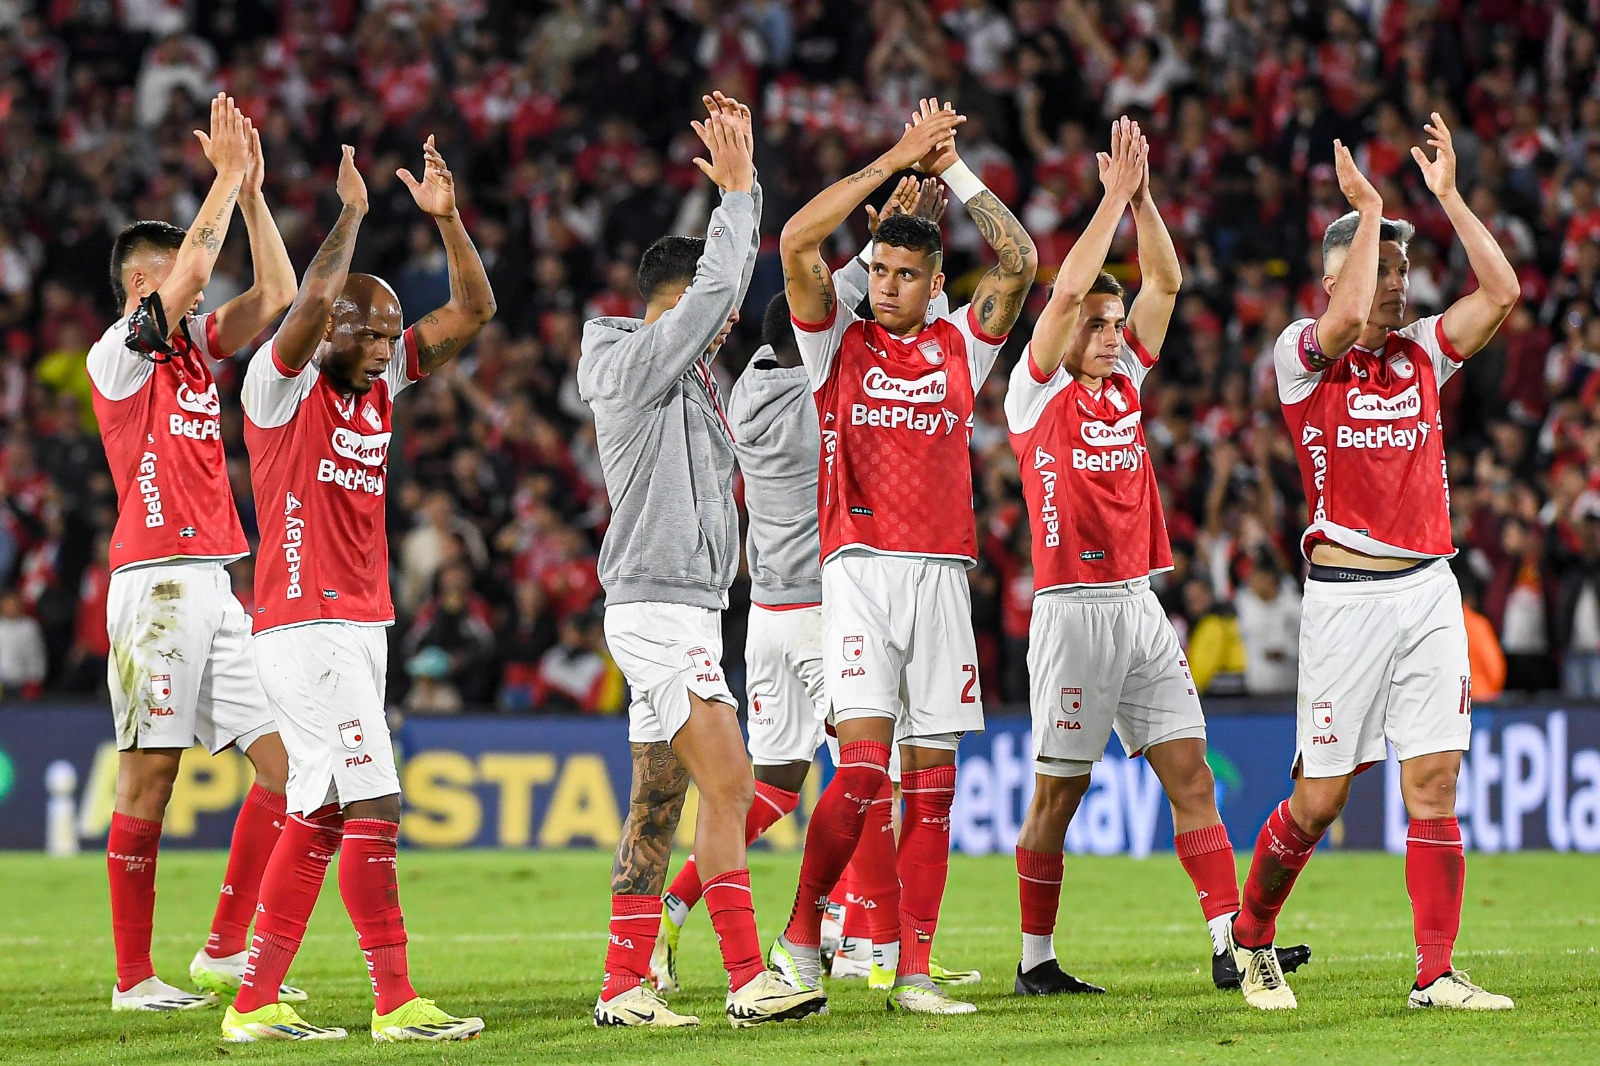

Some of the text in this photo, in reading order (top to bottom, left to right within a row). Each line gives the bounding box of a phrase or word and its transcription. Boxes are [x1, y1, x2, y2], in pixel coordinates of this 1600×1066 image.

[851, 403, 942, 436] BetPlay
[1337, 426, 1418, 451] BetPlay
[317, 458, 384, 496] BetPlay
[136, 451, 165, 528] BetPlay
[282, 516, 305, 600] BetPlay
[696, 673, 721, 682] FILA
[842, 667, 866, 679] FILA
[149, 707, 174, 717] FILA
[1056, 720, 1081, 730] FILA
[1313, 734, 1339, 746] FILA
[344, 754, 372, 768] FILA
